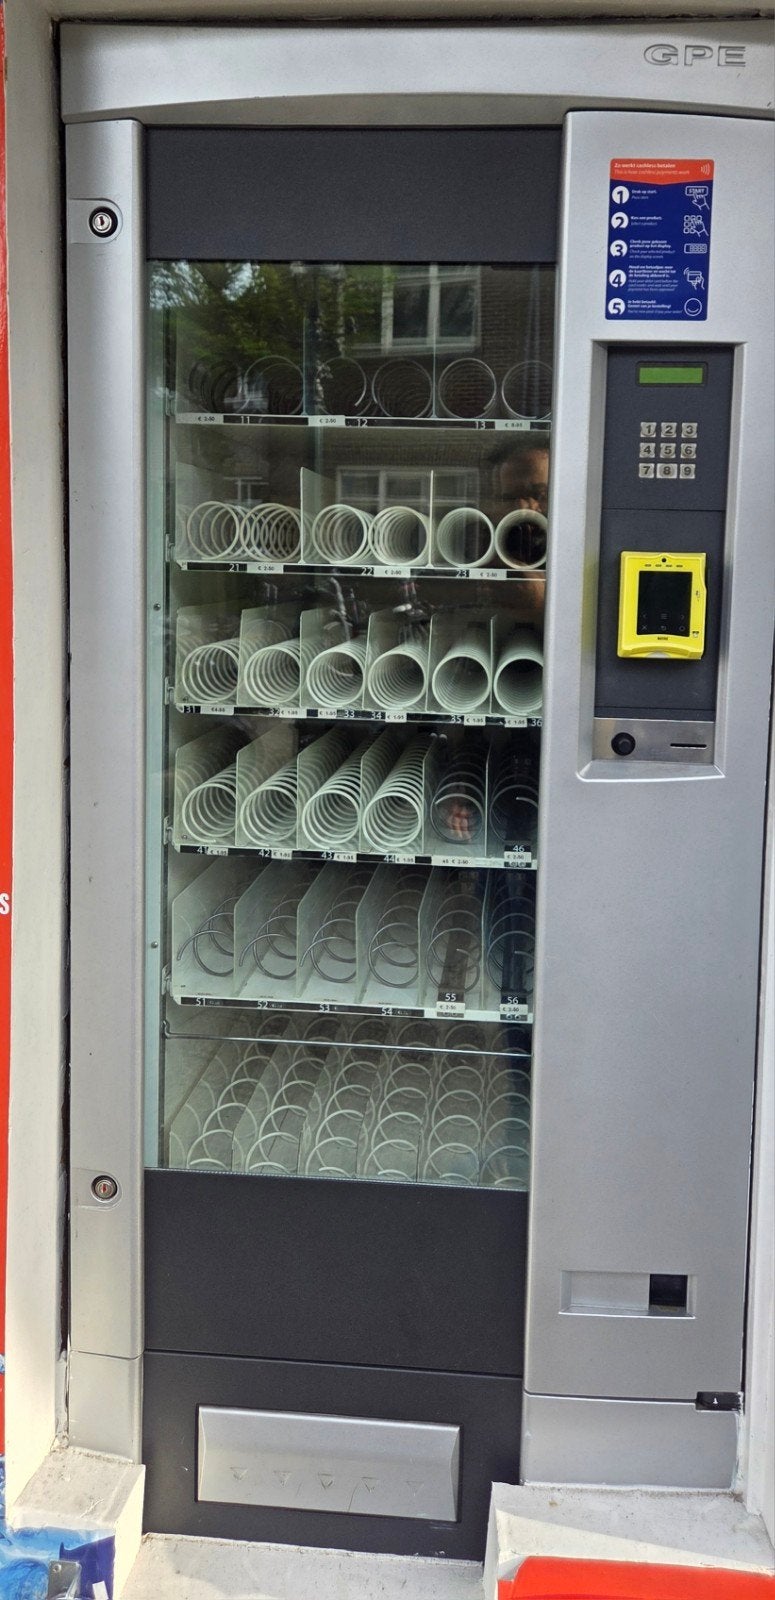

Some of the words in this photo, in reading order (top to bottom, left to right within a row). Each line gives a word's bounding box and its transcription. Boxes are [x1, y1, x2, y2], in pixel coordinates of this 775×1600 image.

[643, 43, 746, 67] GPE
[617, 190, 624, 204] 1
[615, 216, 625, 229] 2
[614, 244, 624, 257] 3
[612, 273, 623, 288] 4
[612, 302, 622, 315] 5
[240, 416, 250, 424] 11
[357, 418, 368, 427] 12
[475, 421, 486, 430] 13
[646, 425, 652, 434] 1
[665, 425, 673, 434] 2
[686, 425, 694, 434] 3
[643, 445, 651, 454] 4
[664, 446, 672, 455] 5
[684, 446, 693, 455] 6
[643, 466, 650, 475] 7
[663, 466, 671, 475] 8
[684, 467, 691, 475] 9
[229, 563, 240, 572] 21
[361, 567, 373, 575] 22
[186, 705, 195, 714] 31
[345, 710, 355, 718] 33
[371, 711, 382, 719] 34
[450, 715, 462, 724] 35
[531, 718, 542, 727] 36
[258, 849, 271, 857] 42
[321, 851, 332, 860] 43
[383, 854, 395, 863] 44
[445, 993, 456, 1001] 55
[507, 996, 519, 1005] 56
[196, 998, 206, 1007] 51
[257, 1000, 269, 1010] 52
[319, 1003, 330, 1012] 53
[381, 1007, 393, 1016] 54
